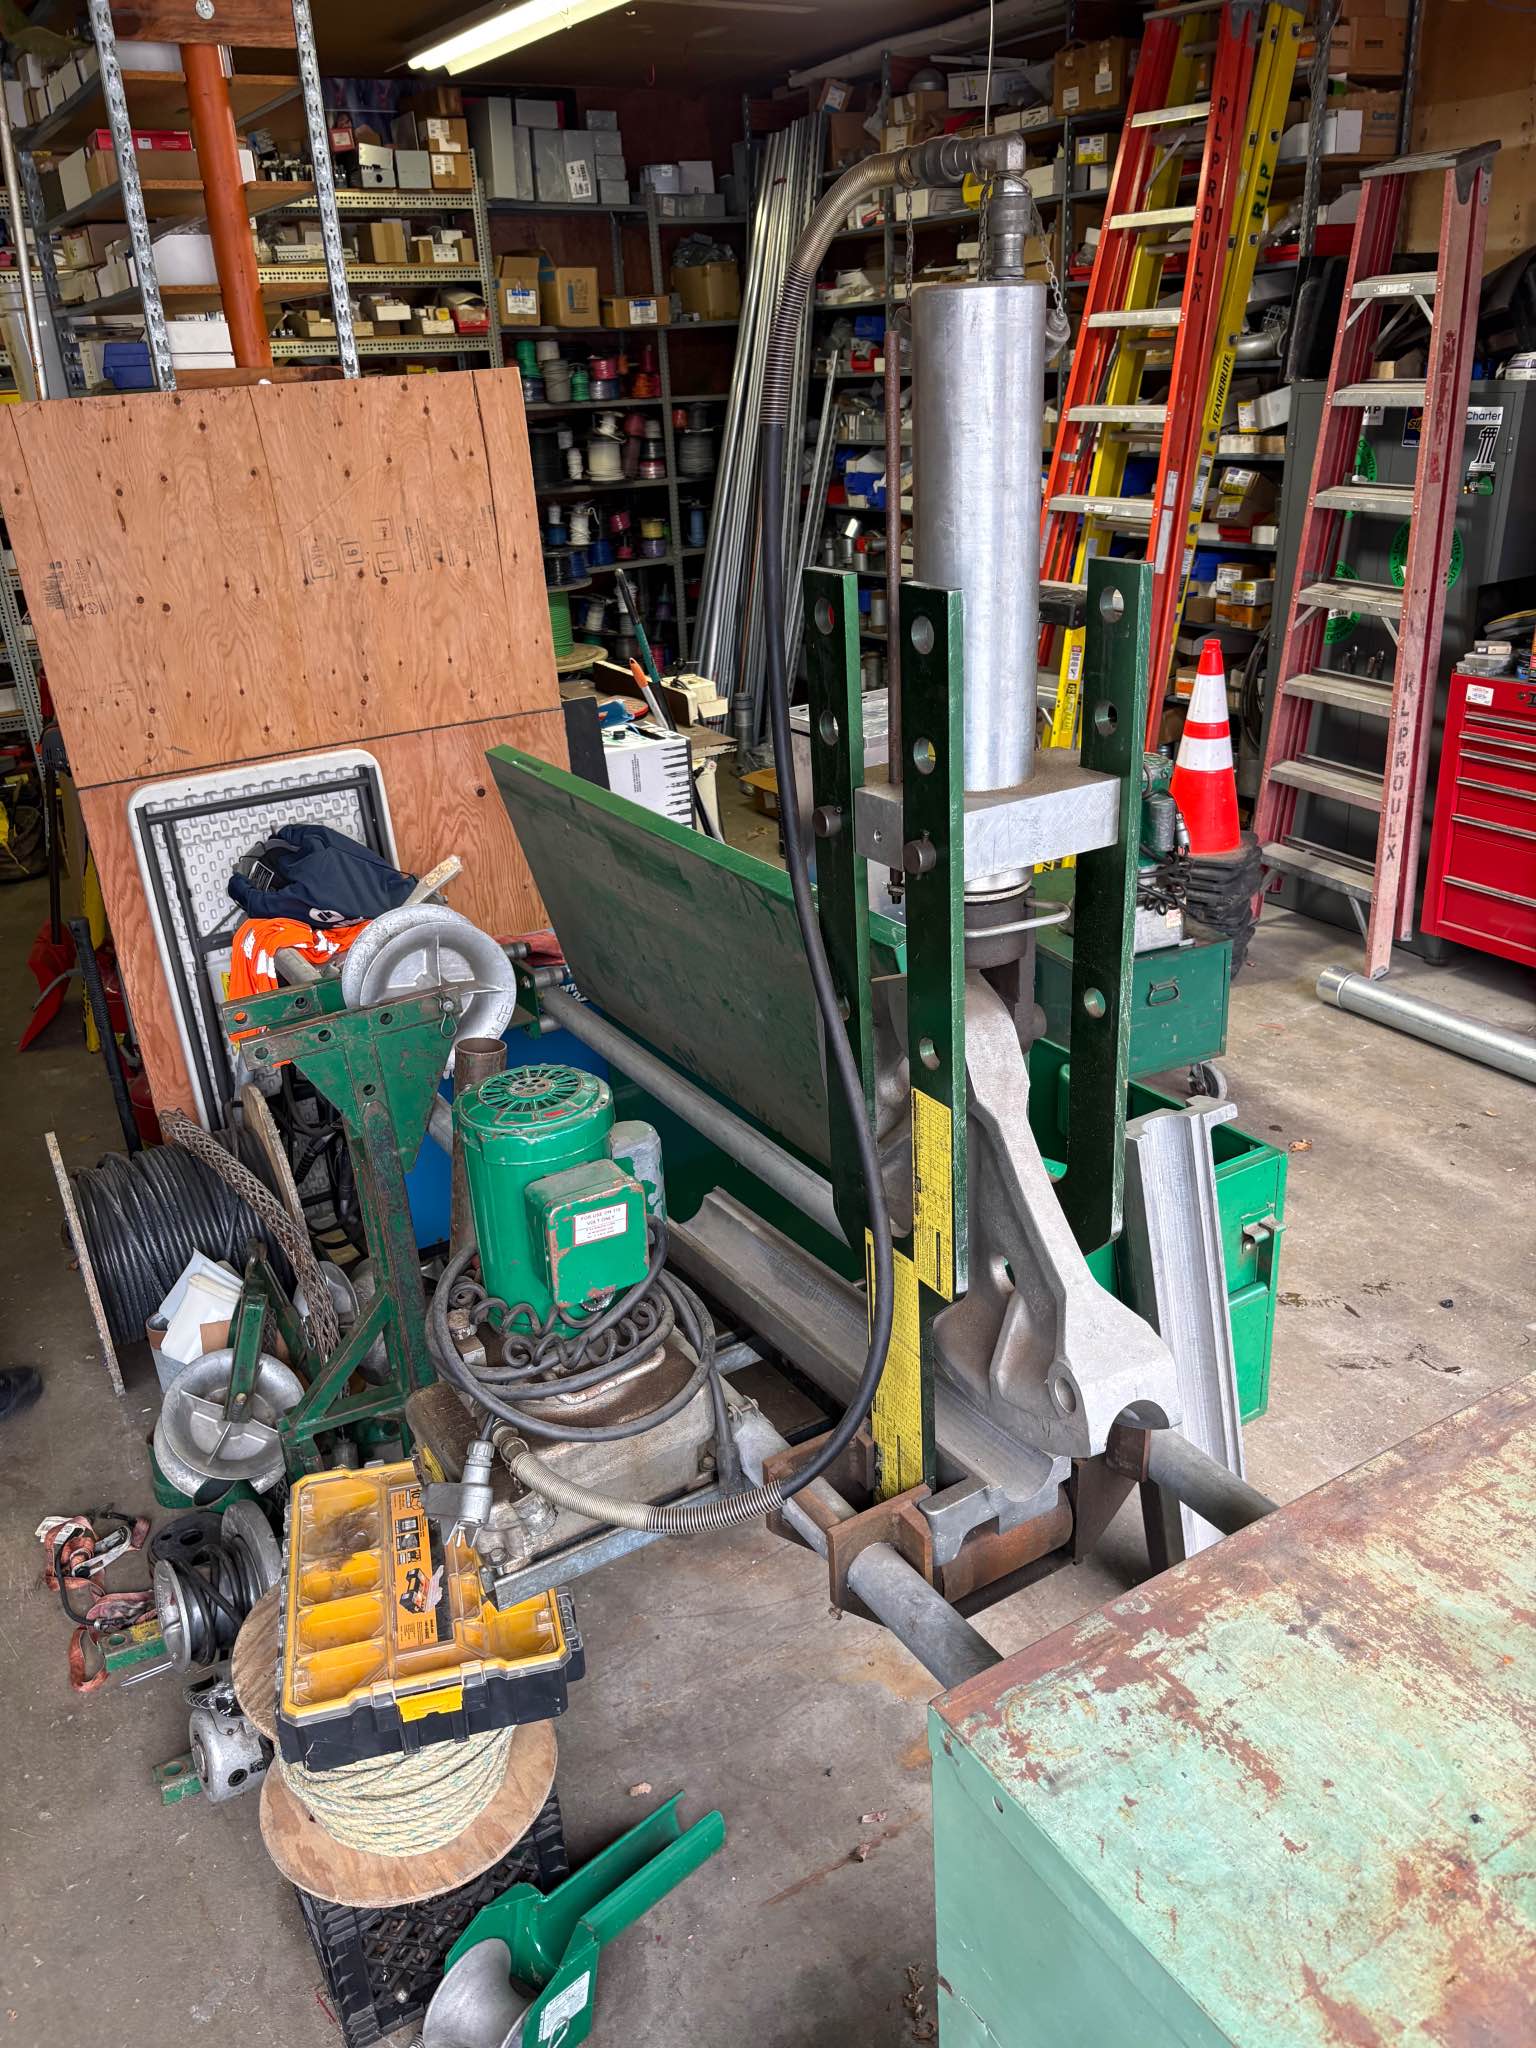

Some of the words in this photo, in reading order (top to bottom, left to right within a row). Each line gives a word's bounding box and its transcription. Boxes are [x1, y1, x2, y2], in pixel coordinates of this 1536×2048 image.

[1251, 163, 1274, 219] RLP
[1212, 353, 1232, 424] FEATHERLITE
[1465, 411, 1501, 421] Charter
